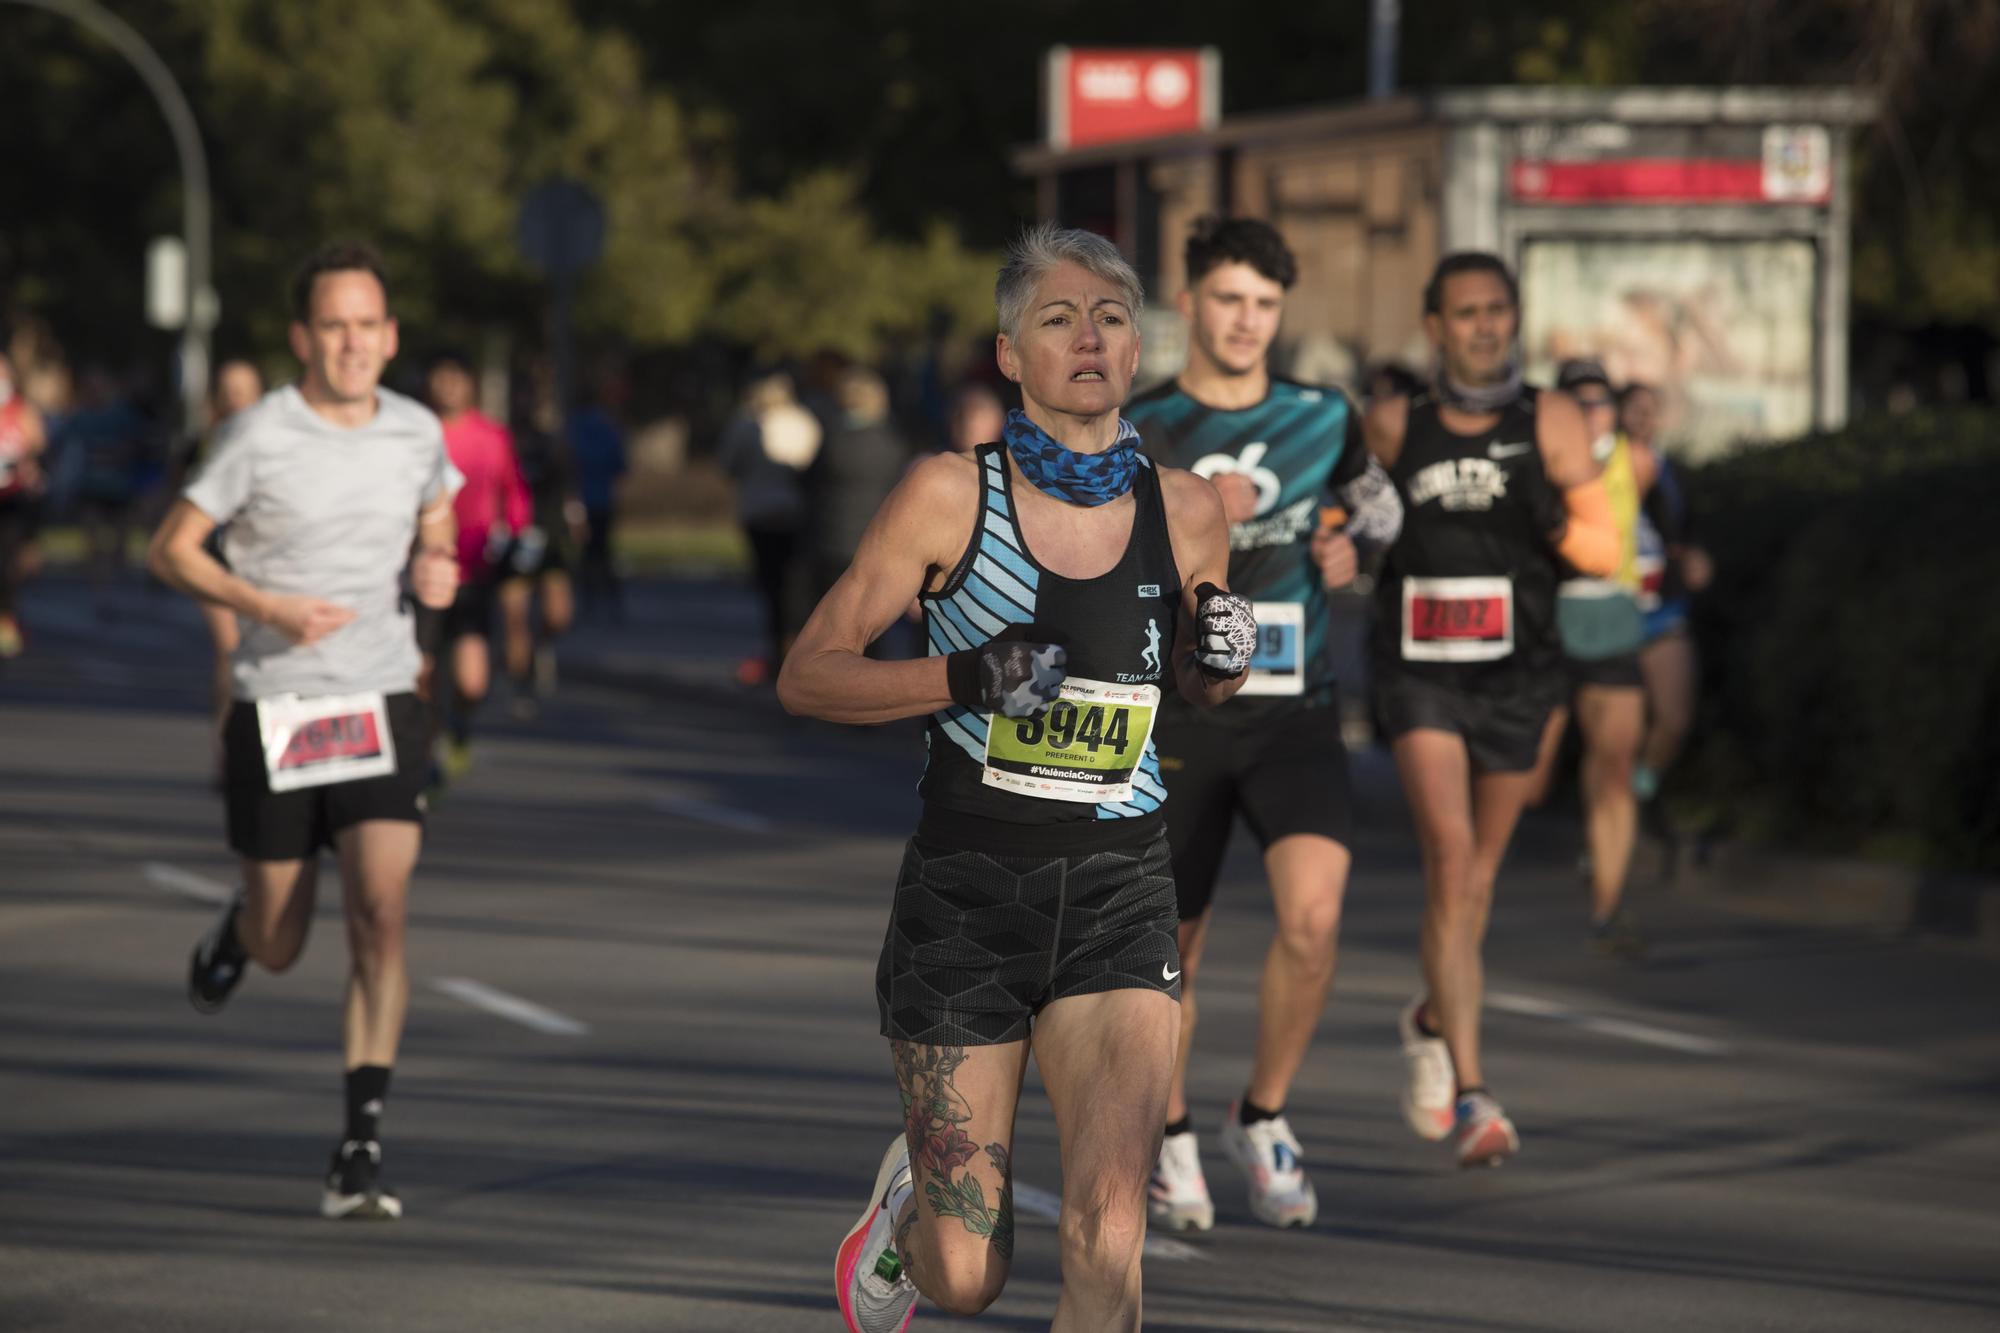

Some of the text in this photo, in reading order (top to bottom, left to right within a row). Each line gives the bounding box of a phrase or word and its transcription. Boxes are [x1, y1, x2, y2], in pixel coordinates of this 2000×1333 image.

[1116, 672, 1144, 682] TEAM
[1016, 700, 1129, 755] 3944
[1045, 751, 1088, 762] PREFERENT
[1030, 765, 1103, 782] #ValènciaCorre
